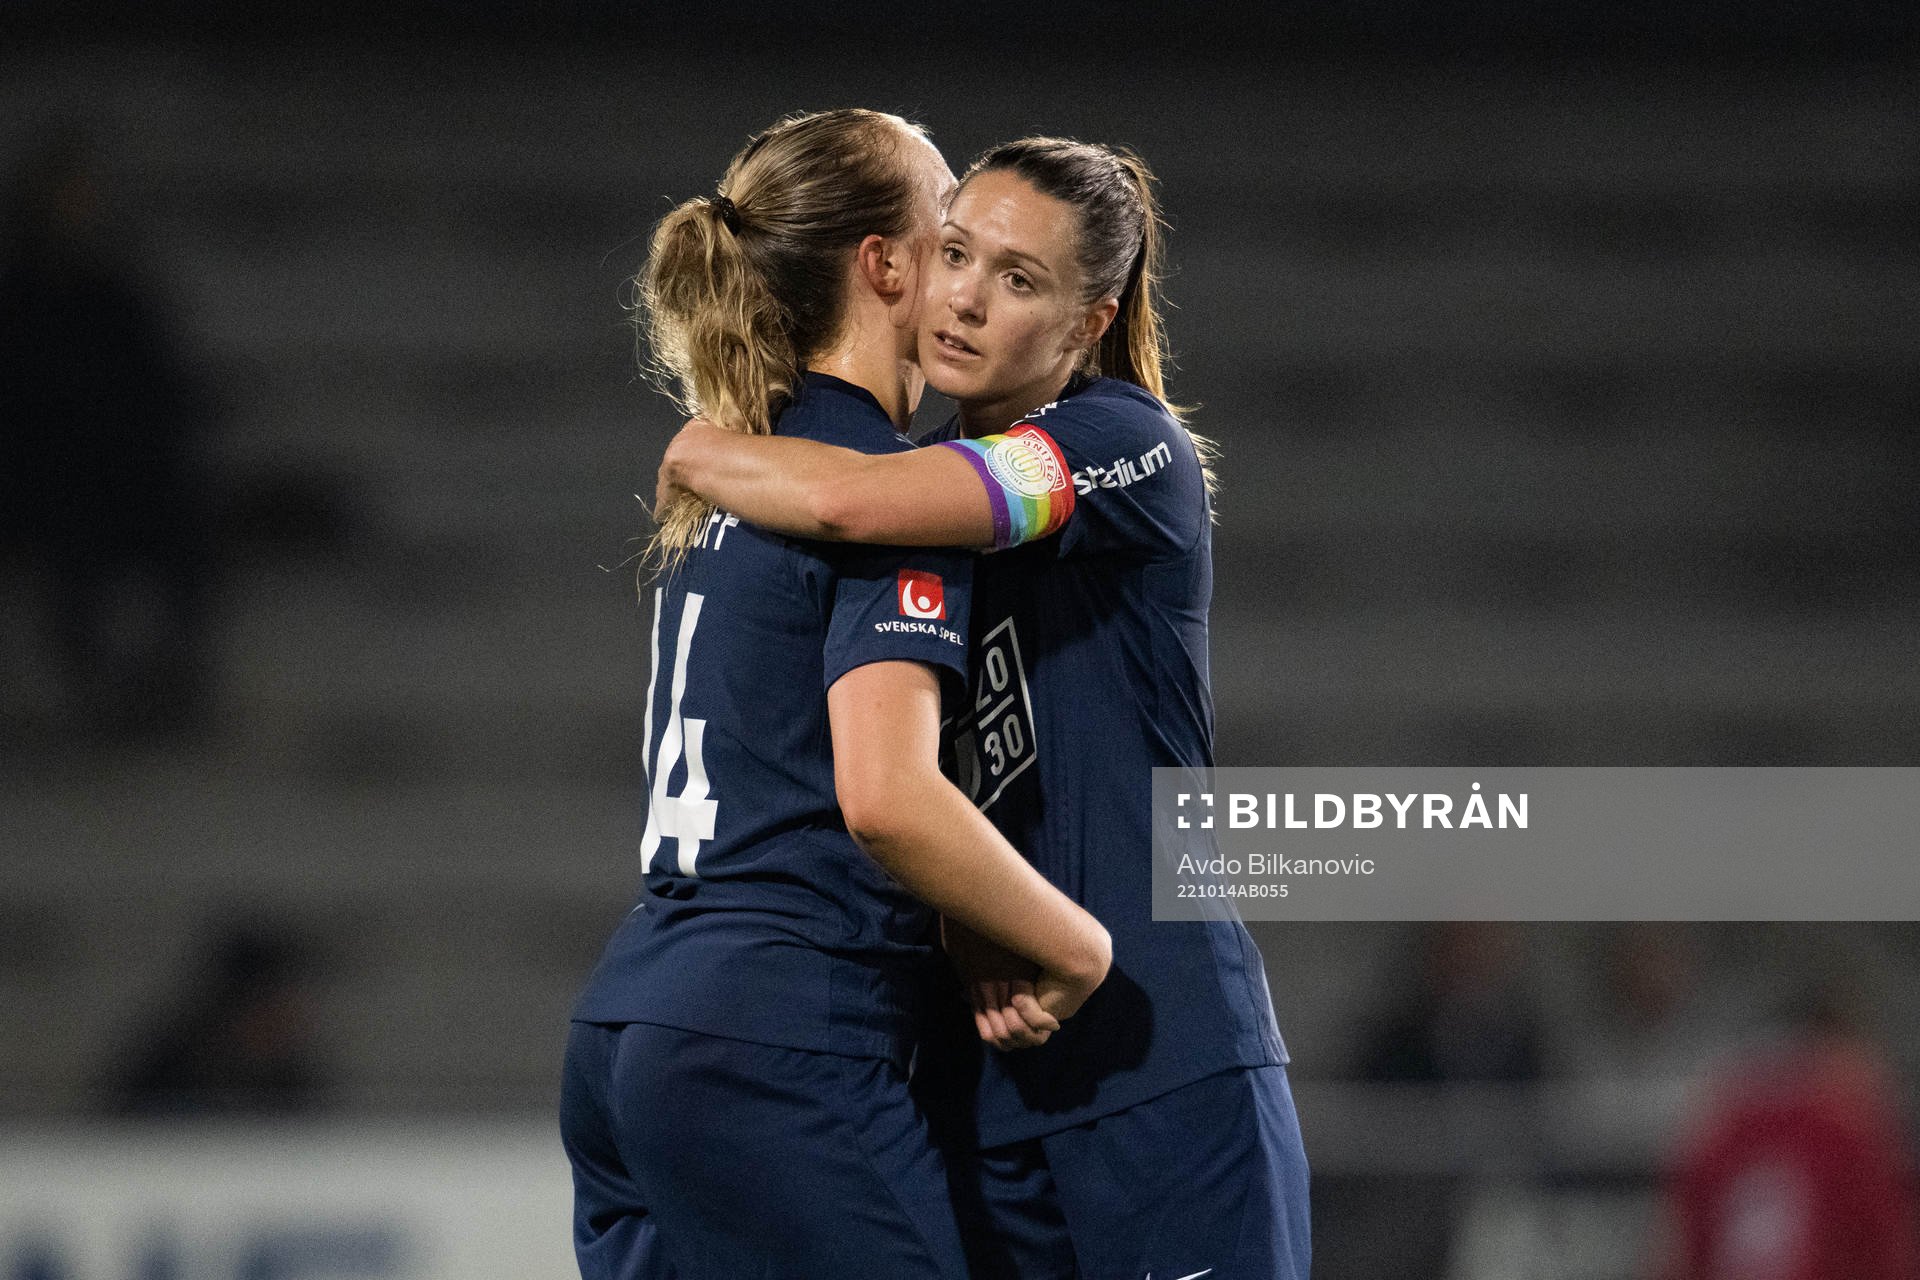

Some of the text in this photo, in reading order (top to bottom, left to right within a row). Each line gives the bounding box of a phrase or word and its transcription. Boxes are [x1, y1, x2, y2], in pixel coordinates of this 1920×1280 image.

[1023, 440, 1054, 482] UNITED
[874, 621, 964, 646] SVENSKA SPEL
[640, 587, 718, 878] 14
[984, 713, 1024, 777] 30
